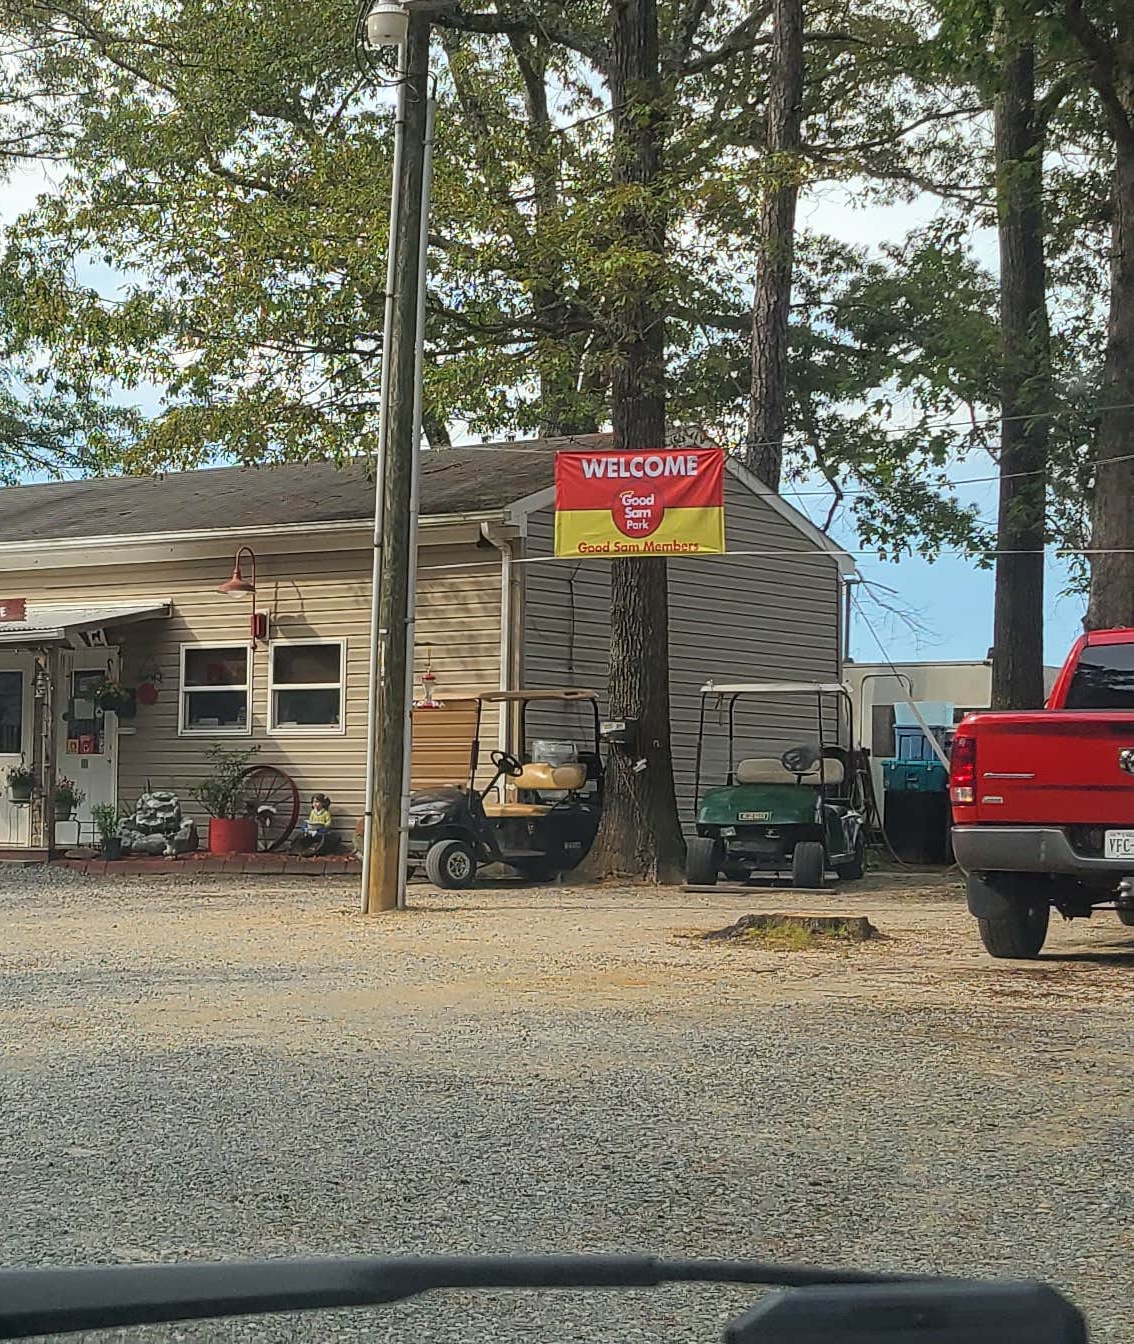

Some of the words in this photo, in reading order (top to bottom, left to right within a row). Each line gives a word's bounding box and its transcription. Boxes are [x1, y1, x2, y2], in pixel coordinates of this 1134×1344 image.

[582, 456, 698, 478] WELCOME
[621, 493, 655, 505] Good
[624, 508, 651, 518] Sam
[626, 520, 649, 530] Park
[577, 542, 610, 554] Good
[613, 541, 639, 553] Sam
[643, 539, 700, 553] Members
